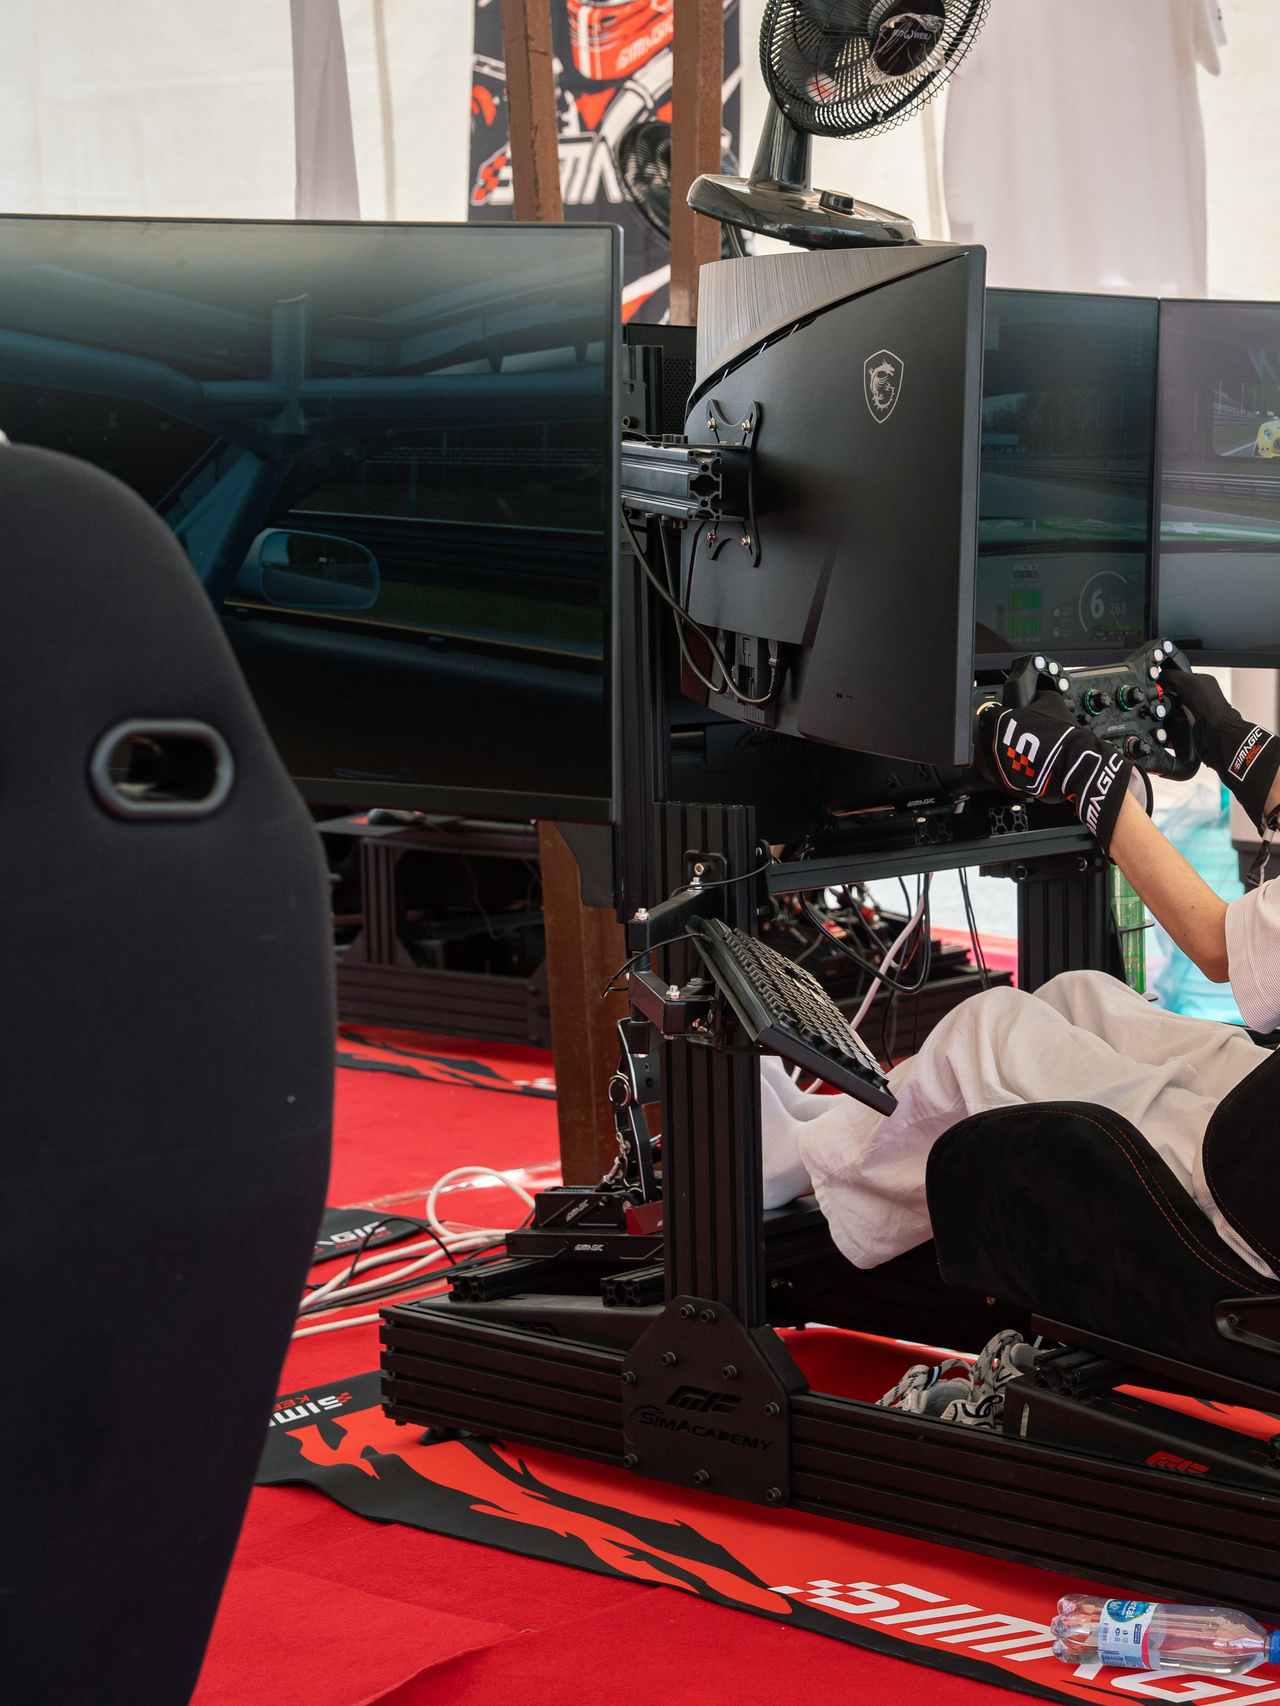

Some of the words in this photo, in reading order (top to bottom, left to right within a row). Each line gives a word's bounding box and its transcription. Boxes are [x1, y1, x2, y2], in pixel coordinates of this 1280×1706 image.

[1091, 588, 1104, 619] 6
[1233, 728, 1263, 772] SIMAGIC
[1085, 753, 1124, 837] IMAGIC
